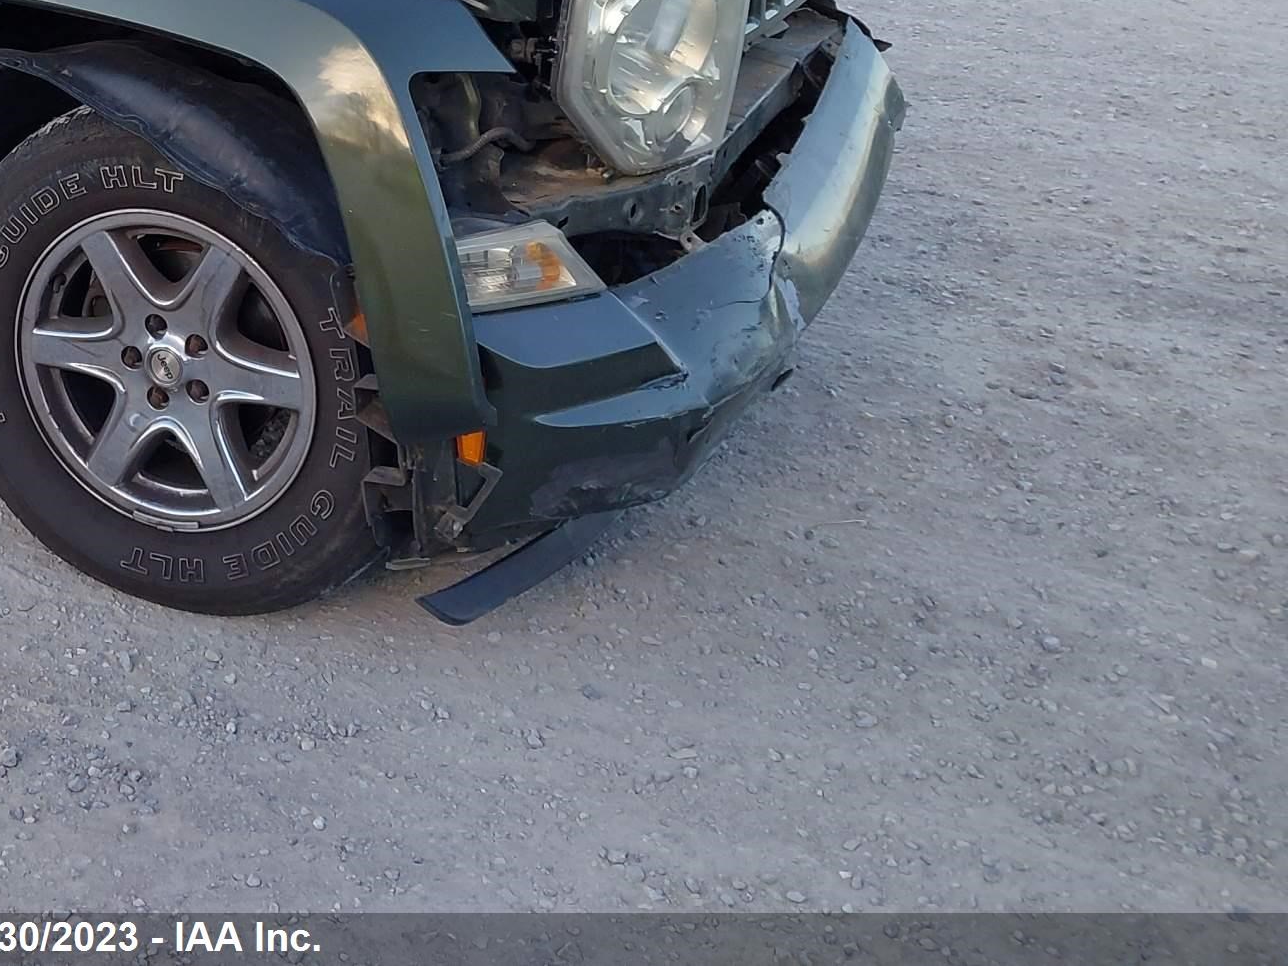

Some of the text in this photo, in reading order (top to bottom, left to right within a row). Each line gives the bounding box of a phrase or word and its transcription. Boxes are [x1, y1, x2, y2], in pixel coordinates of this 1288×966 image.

[99, 165, 185, 194] HLT
[157, 353, 174, 380] Jeep
[120, 307, 359, 583] TRAIL GUIDE HLT
